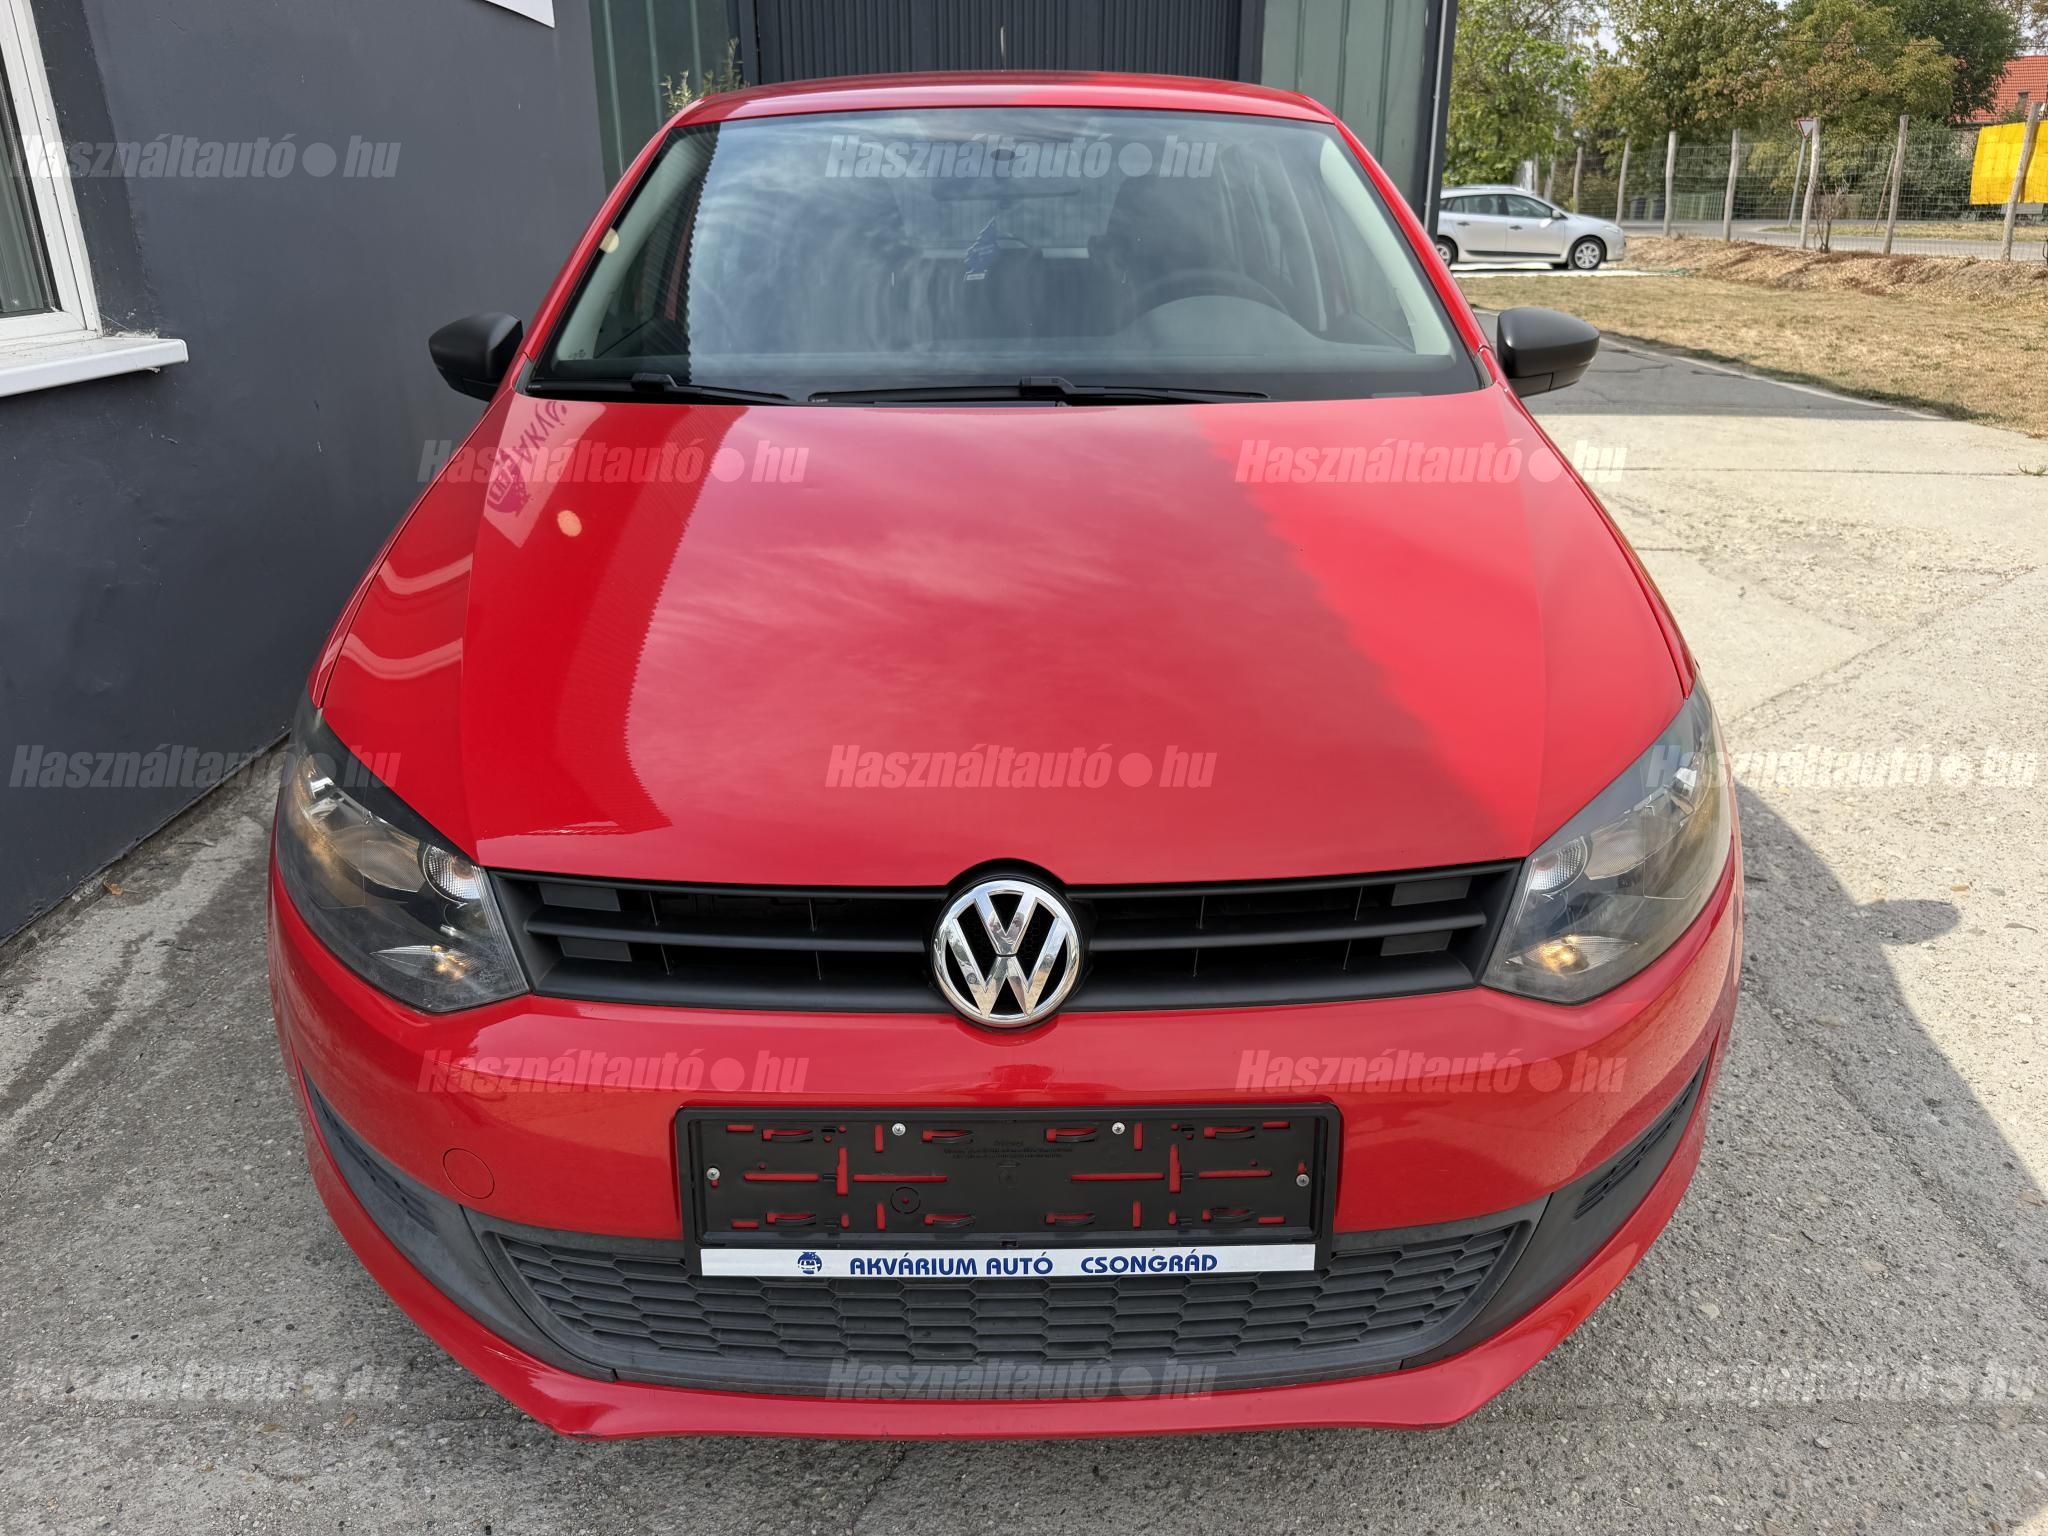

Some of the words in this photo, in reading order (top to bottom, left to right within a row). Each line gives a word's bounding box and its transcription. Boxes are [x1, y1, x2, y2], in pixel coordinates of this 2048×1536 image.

[850, 1252, 978, 1275] AKVÁRIUM
[986, 1251, 1054, 1275] AUTÓ
[1081, 1249, 1218, 1274] CSONGRÁD
